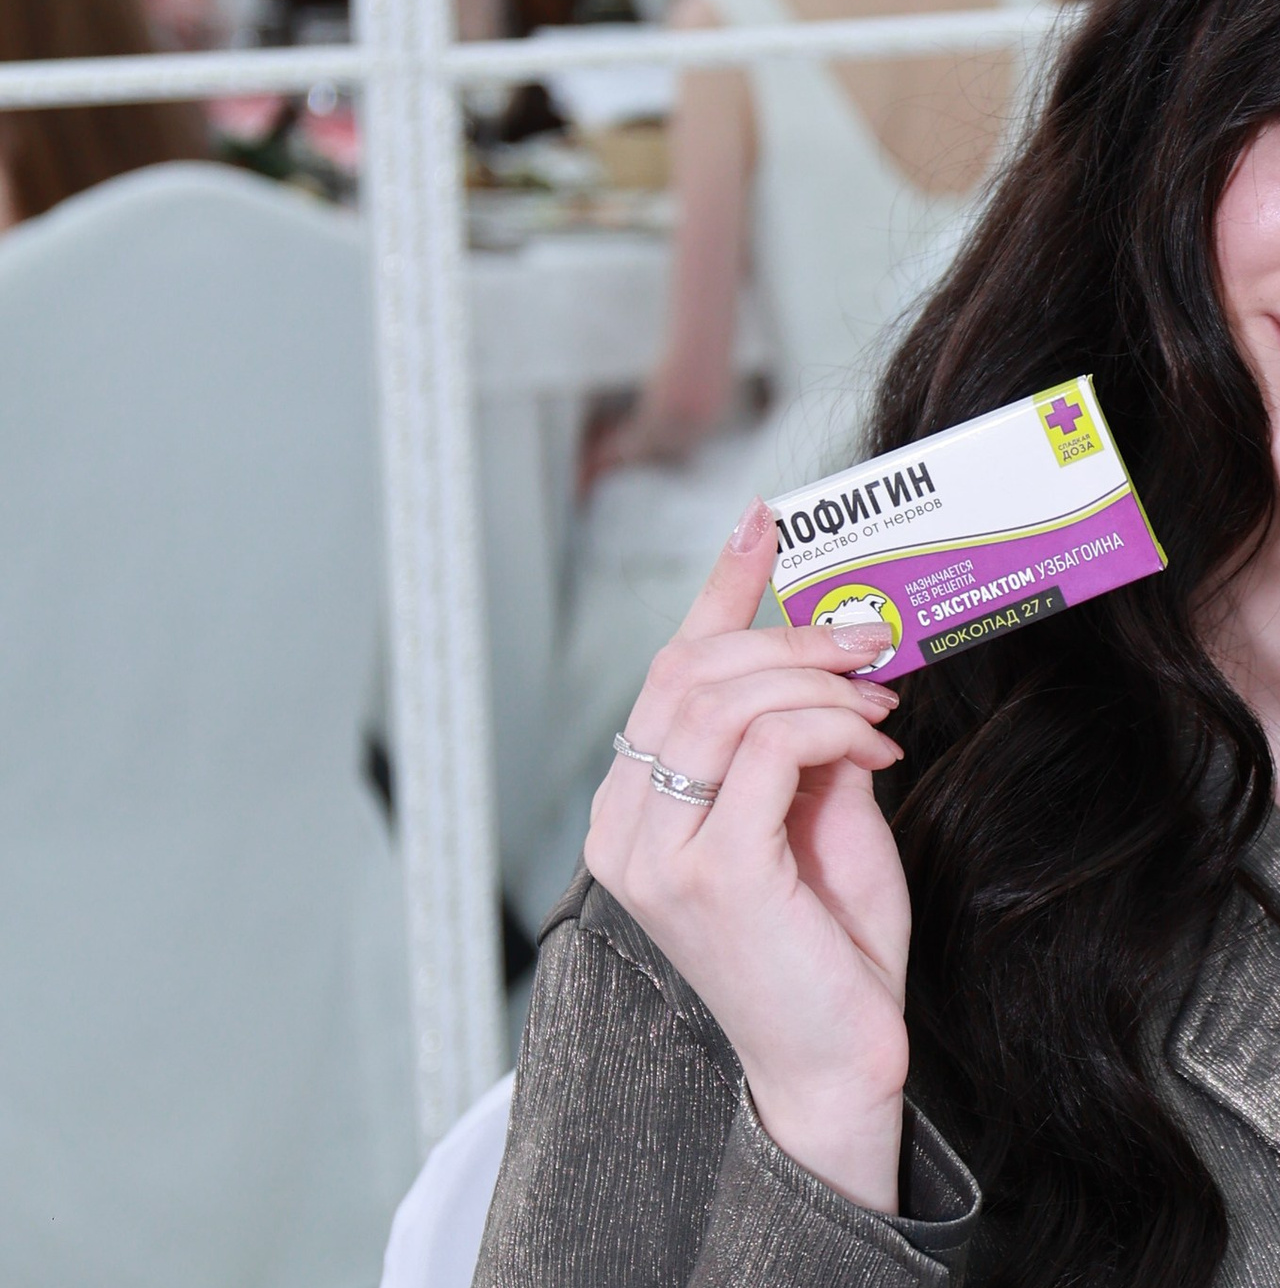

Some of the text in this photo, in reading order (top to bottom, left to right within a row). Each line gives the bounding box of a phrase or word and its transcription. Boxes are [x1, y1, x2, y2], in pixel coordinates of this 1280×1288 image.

[1058, 433, 1091, 451] СЛАДКАЯ
[1063, 441, 1095, 461] ДОЗА
[781, 498, 943, 570] средство от нервов
[904, 559, 974, 595] НАЗНАЧАЕТСЯ
[909, 573, 976, 607] БЕЗ РЕЦЕПТА
[916, 532, 1125, 627] С ЭКСТРАКТОМ УЗБАГОИНА
[930, 608, 1020, 654] ШОКОЛАД
[1021, 599, 1040, 618] 27
